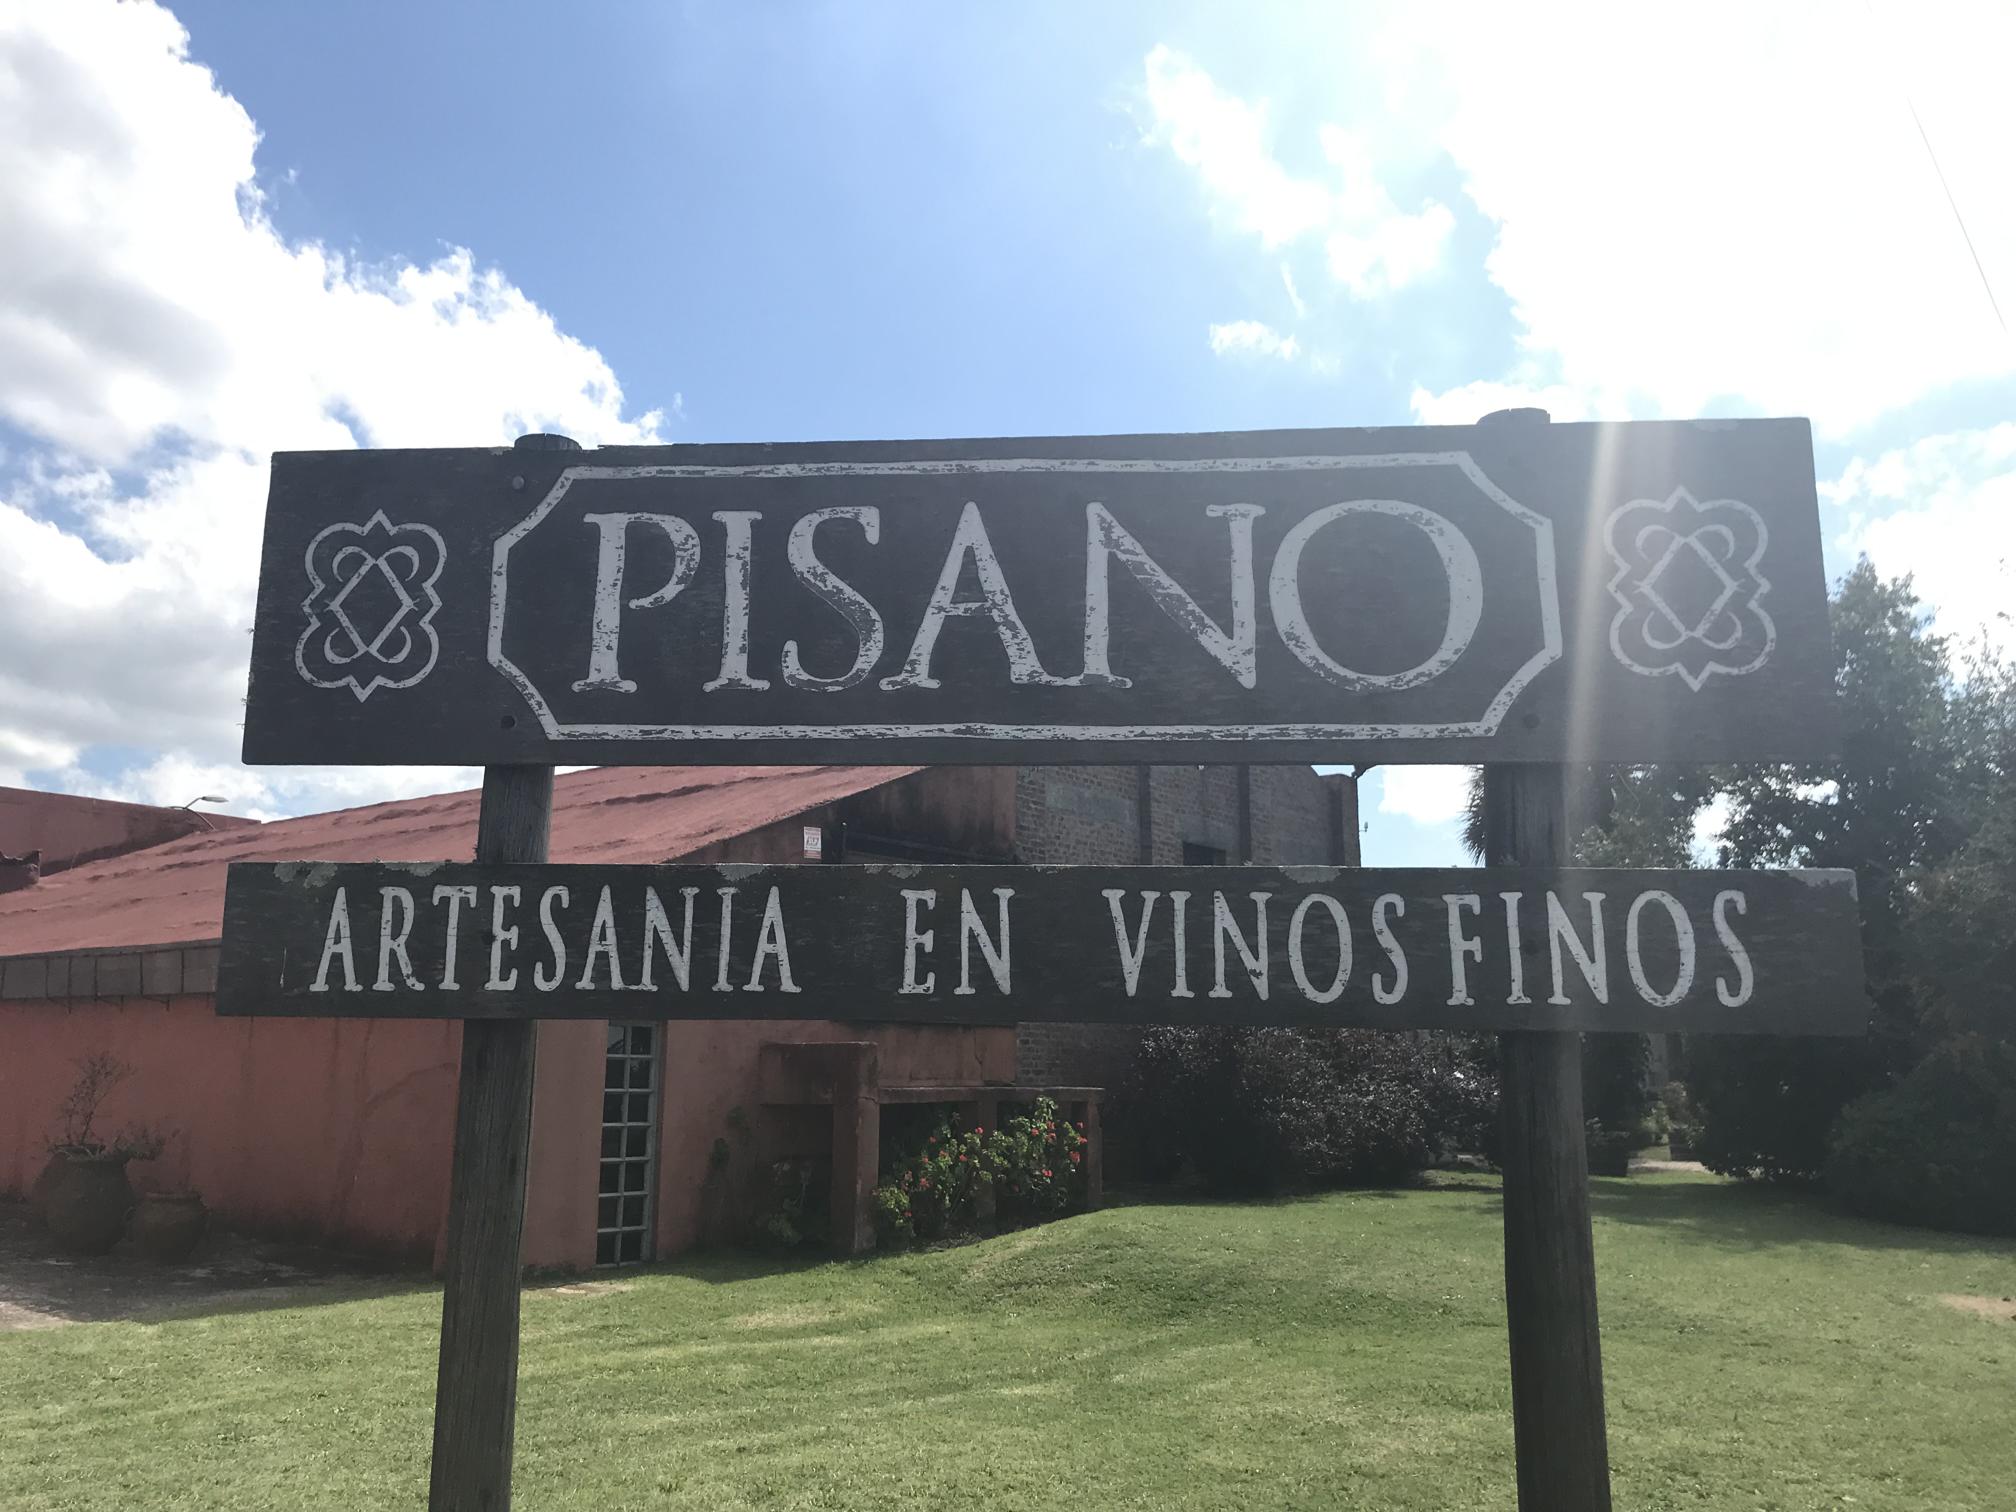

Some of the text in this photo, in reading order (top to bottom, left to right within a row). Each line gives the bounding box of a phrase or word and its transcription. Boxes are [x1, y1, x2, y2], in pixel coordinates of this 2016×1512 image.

[571, 499, 1483, 692] PISANO
[309, 885, 1755, 1008] ARTESANIA EN VINOS FINOS
